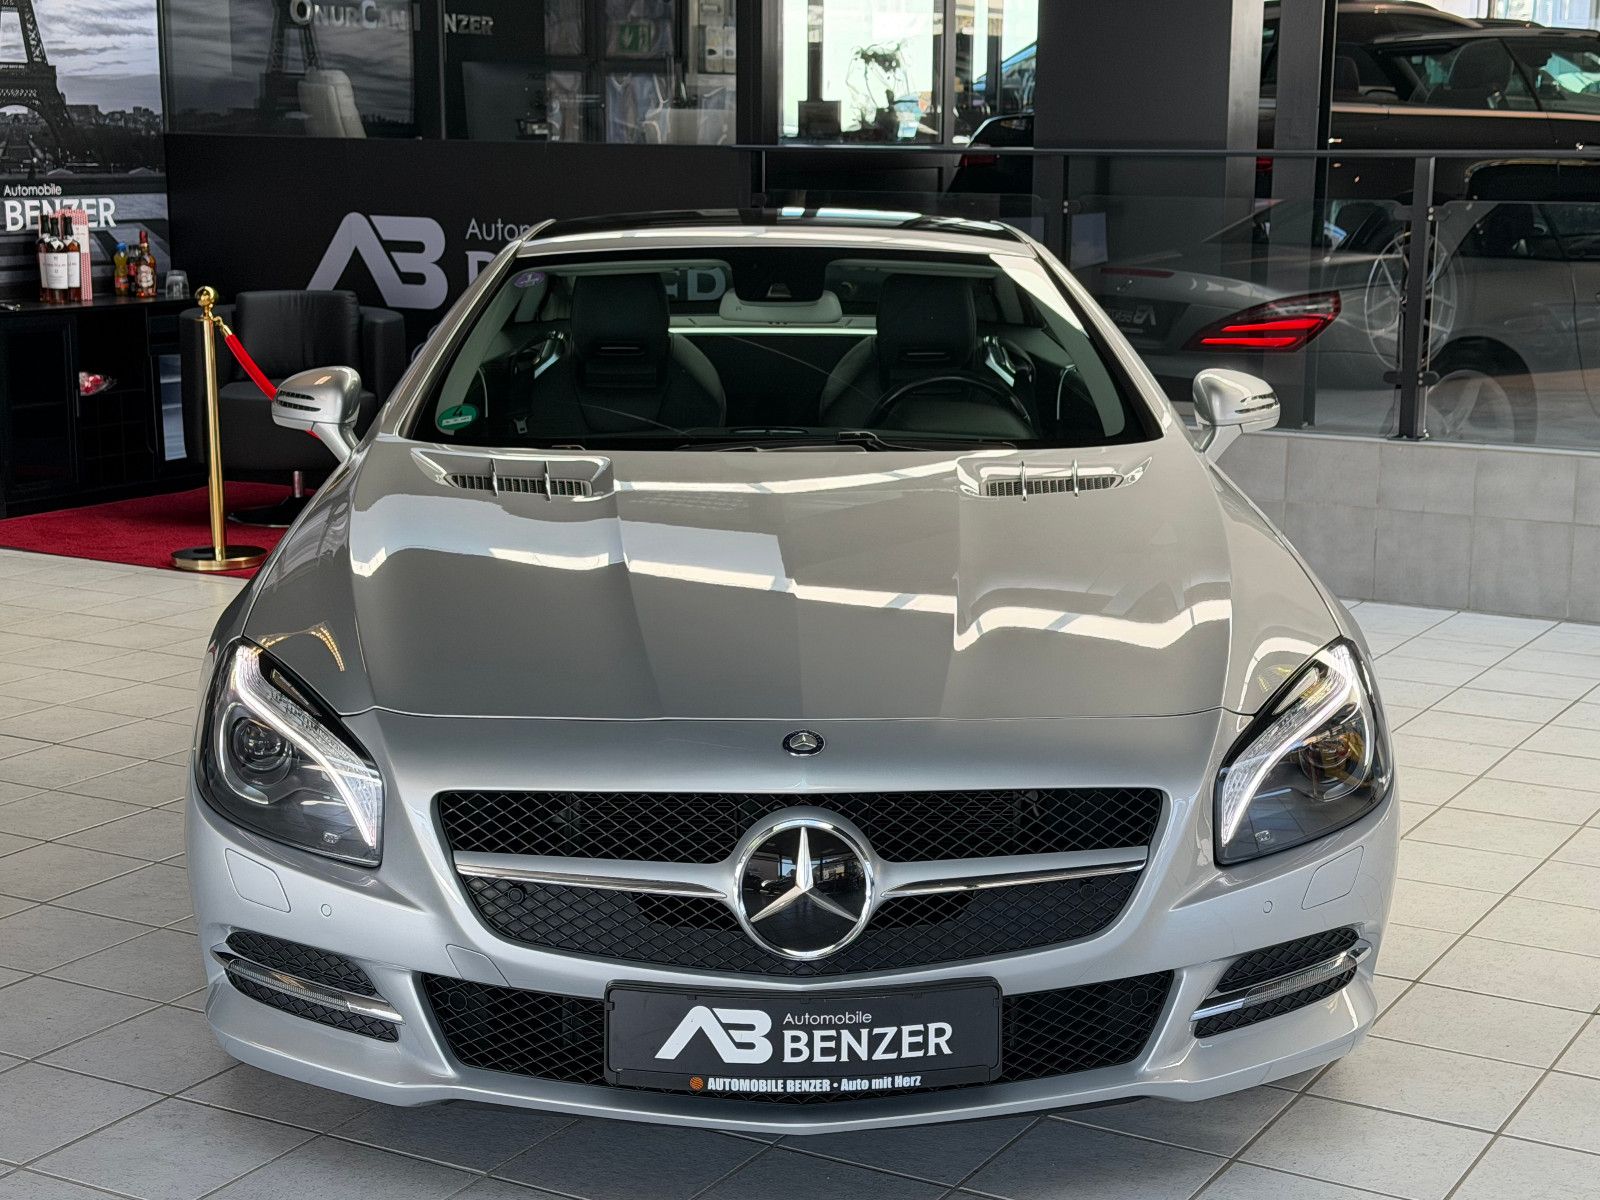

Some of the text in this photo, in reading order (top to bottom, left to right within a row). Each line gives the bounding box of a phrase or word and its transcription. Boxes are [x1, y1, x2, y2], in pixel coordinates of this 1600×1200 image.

[3, 183, 62, 197] Automobile
[783, 1011, 873, 1026] Automobile
[783, 1022, 953, 1063] BENZER
[707, 1074, 922, 1093] AUTOMOBILE BENZER Auto mit Herz
